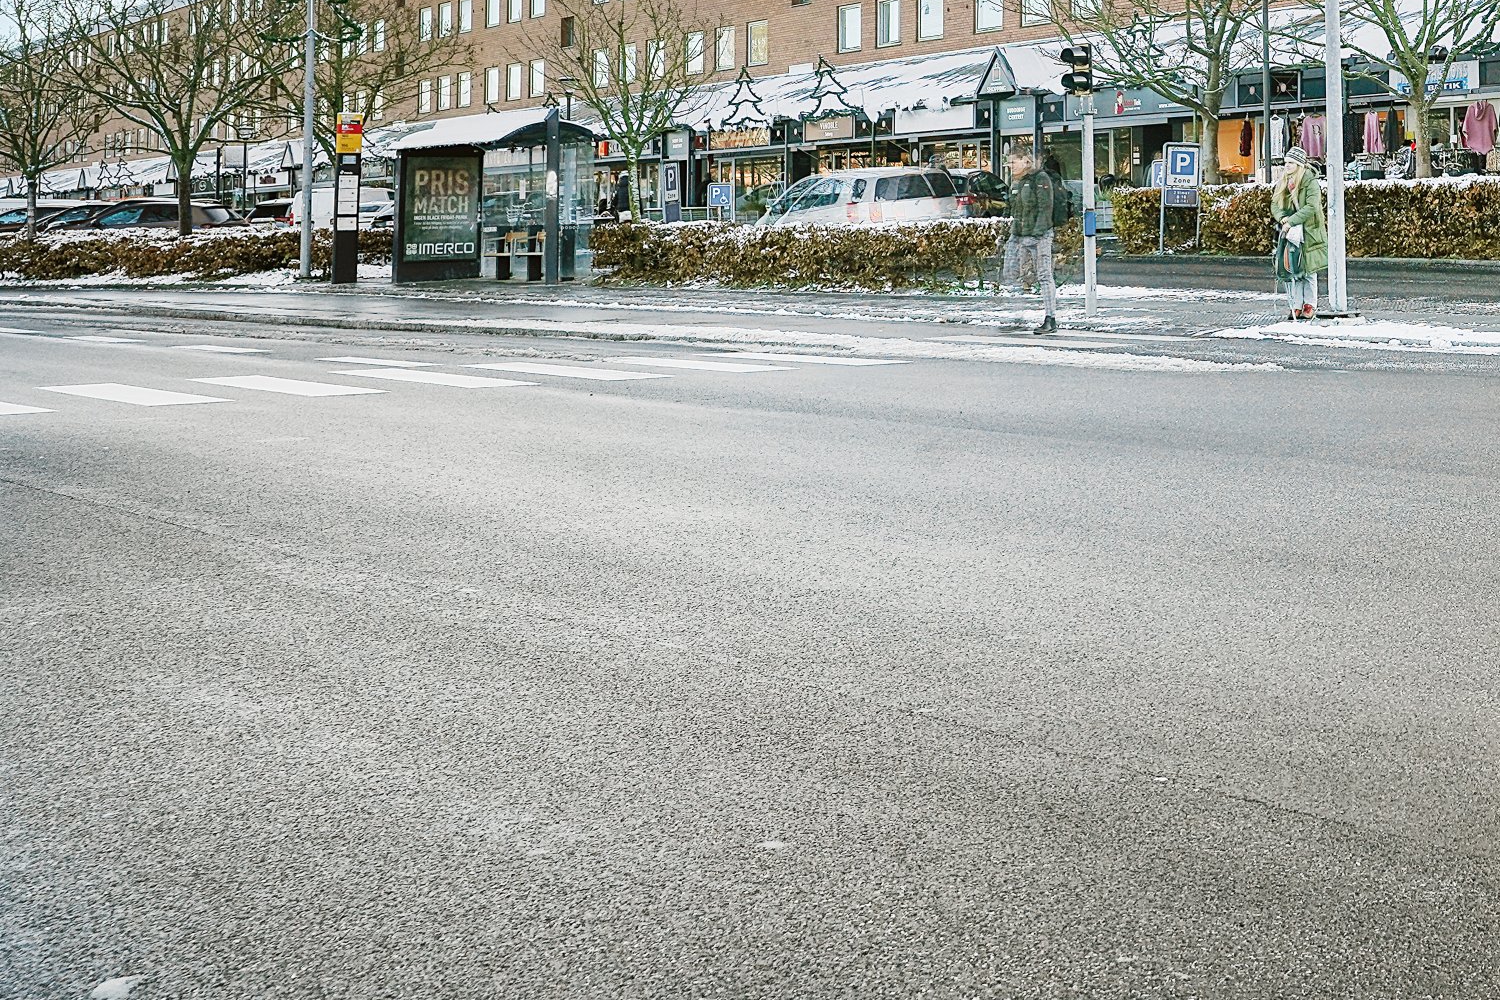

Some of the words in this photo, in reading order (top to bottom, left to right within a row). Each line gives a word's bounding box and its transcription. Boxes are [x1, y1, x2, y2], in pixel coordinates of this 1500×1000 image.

[1176, 153, 1191, 173] P
[414, 170, 469, 195] PRIS
[712, 187, 721, 199] P
[413, 196, 470, 214] MATCH
[419, 242, 475, 255] IMERCO
